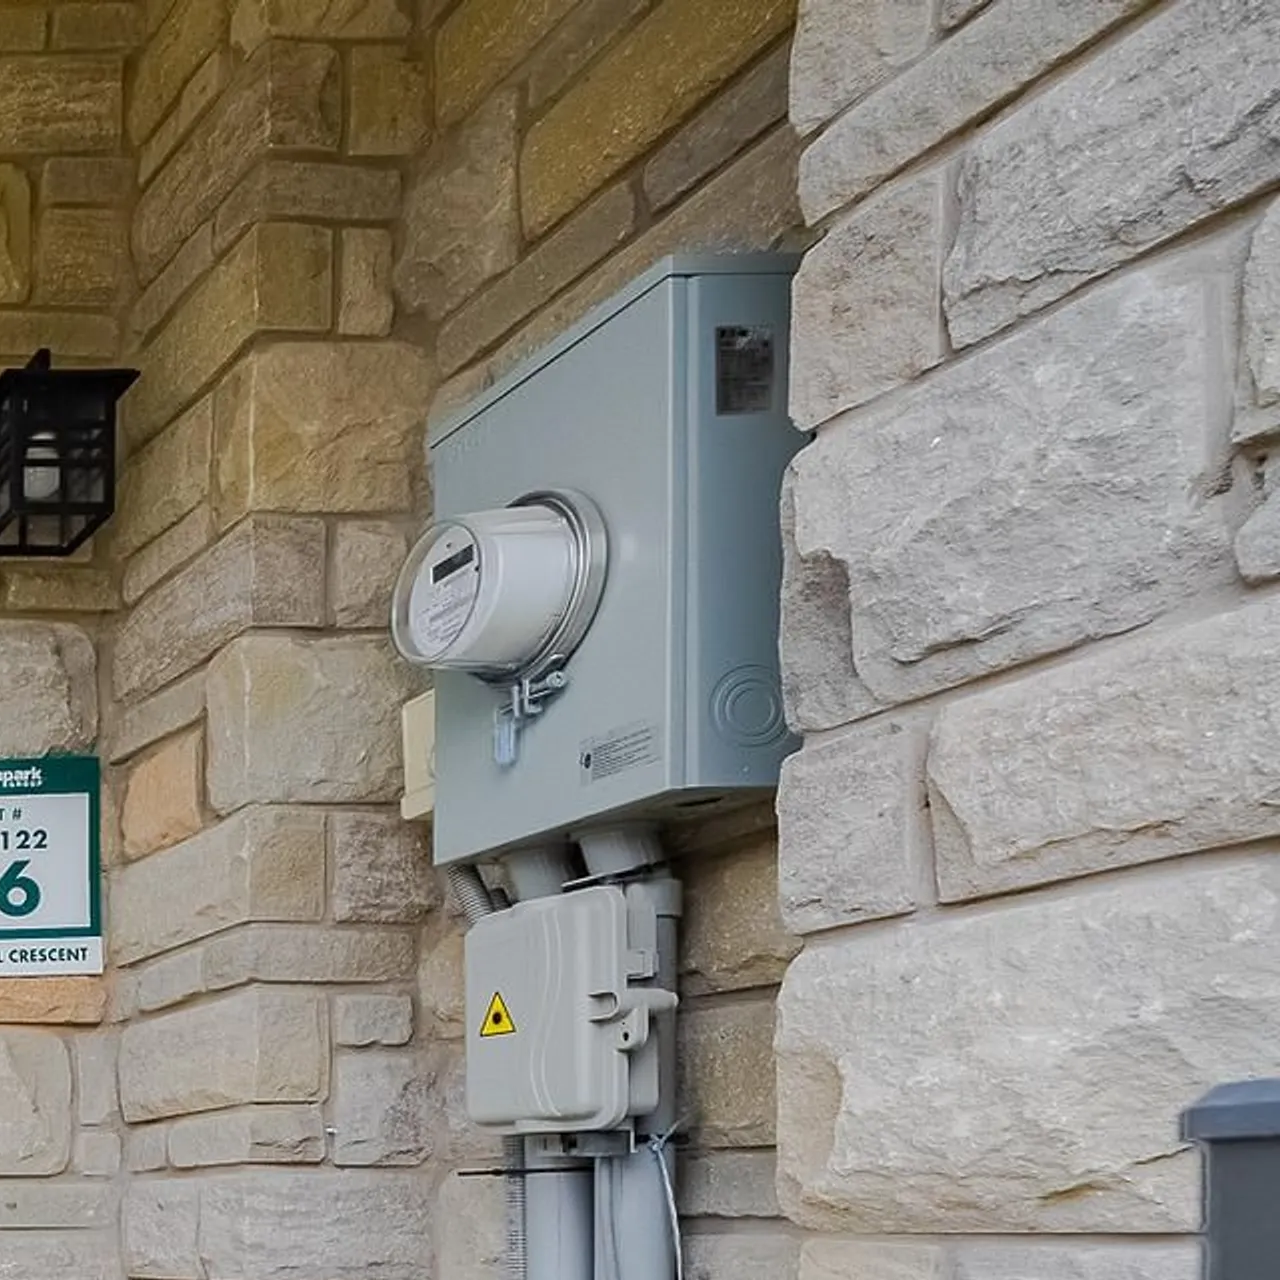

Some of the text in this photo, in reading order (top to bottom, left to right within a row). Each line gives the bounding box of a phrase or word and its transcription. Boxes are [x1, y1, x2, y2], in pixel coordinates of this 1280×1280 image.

[12, 808, 22, 819] #
[0, 830, 48, 850] 122
[9, 948, 88, 963] CRESCENT
